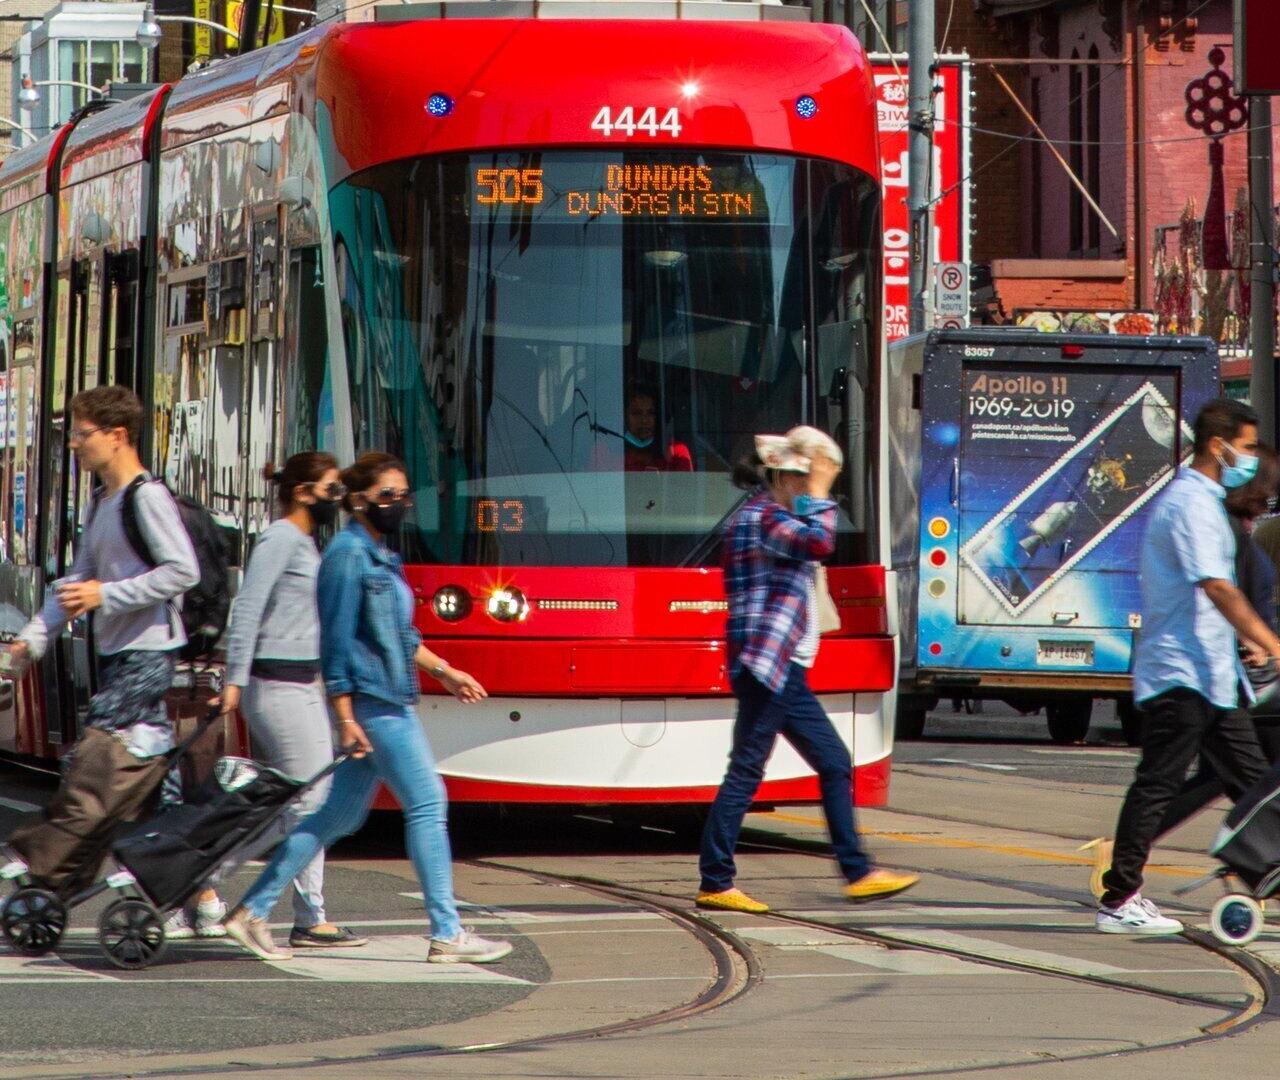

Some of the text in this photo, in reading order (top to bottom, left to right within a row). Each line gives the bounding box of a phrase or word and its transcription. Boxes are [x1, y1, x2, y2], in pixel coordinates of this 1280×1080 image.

[591, 106, 682, 138] 4444
[477, 169, 543, 203] 505
[606, 164, 712, 191] DUNDAS
[568, 192, 752, 215] DUNDAS W STN
[940, 302, 964, 311] ROUTE
[965, 347, 995, 357] 63057
[970, 374, 1067, 396] Apollo 11
[969, 396, 1075, 418] 1969-2019
[478, 500, 524, 532] 03
